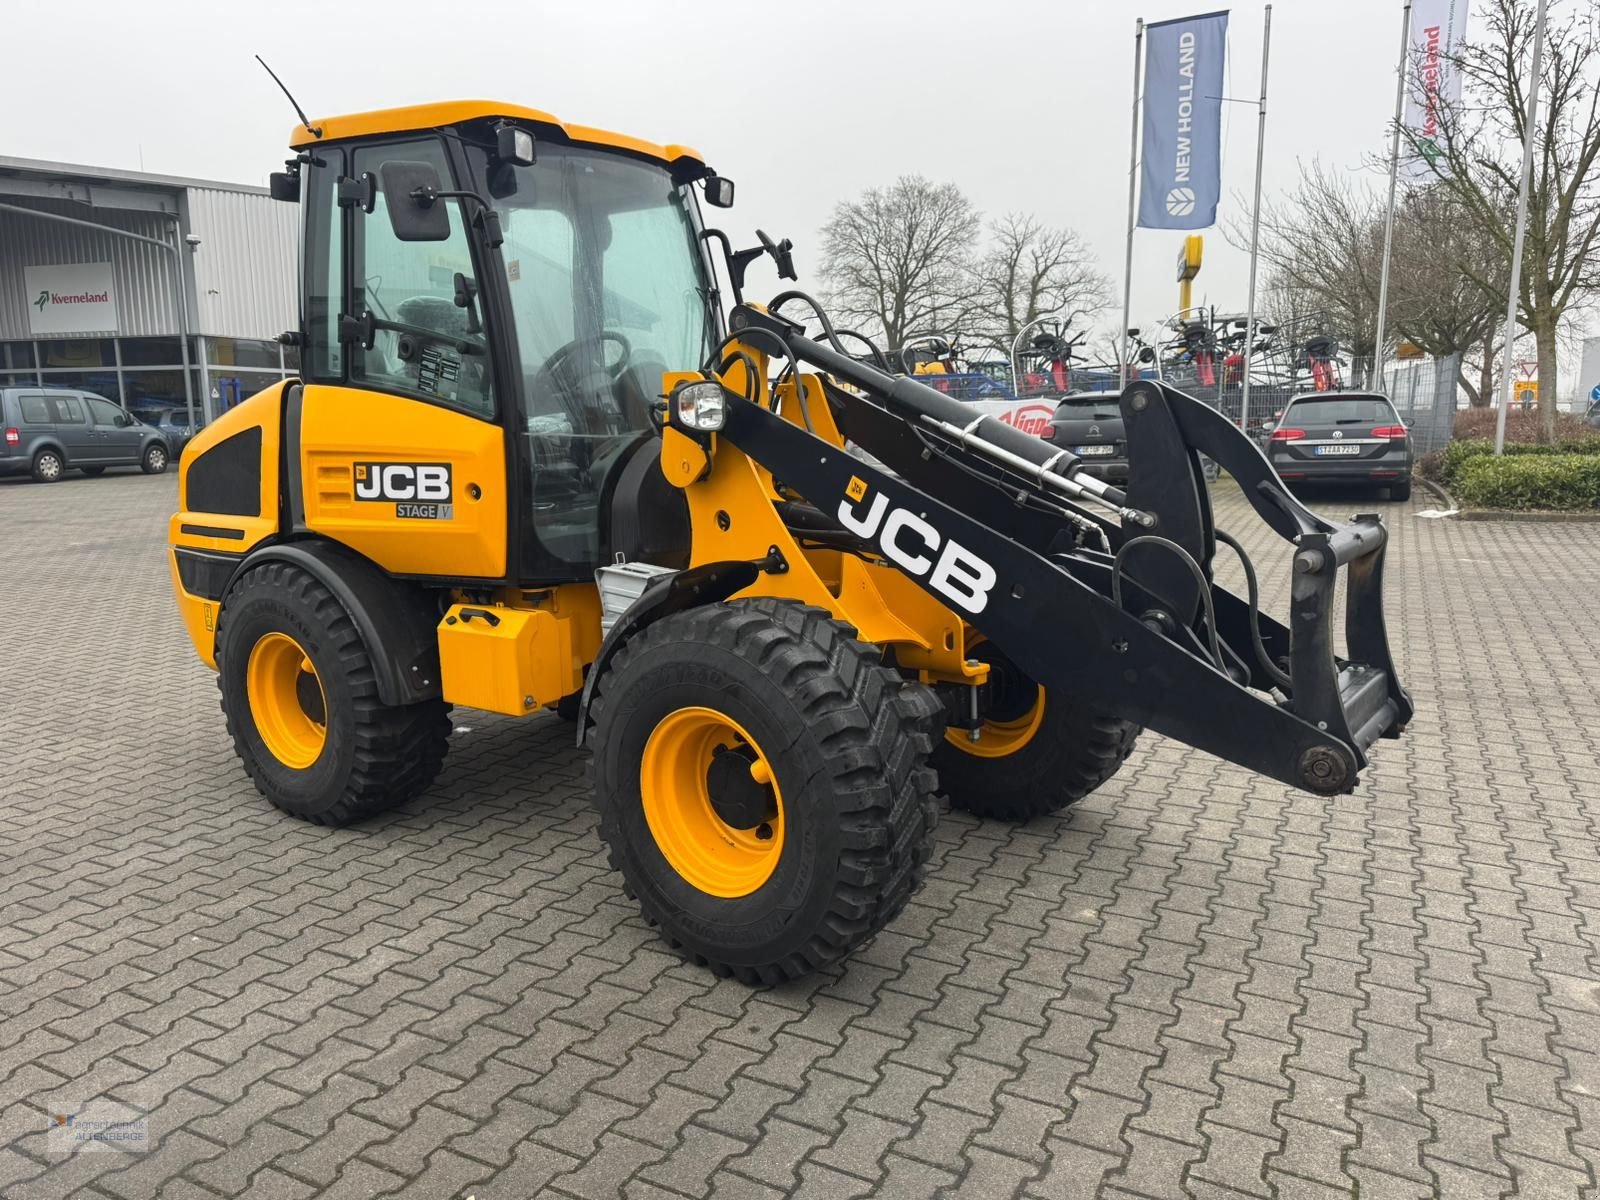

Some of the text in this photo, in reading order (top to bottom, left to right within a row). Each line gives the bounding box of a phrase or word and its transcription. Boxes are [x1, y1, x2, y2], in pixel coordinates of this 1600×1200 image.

[1175, 31, 1195, 182] NEW HOLLAND
[51, 290, 109, 305] Kverneland
[356, 465, 450, 500] JCB
[397, 504, 436, 518] STAGE
[837, 491, 997, 614] JCB
